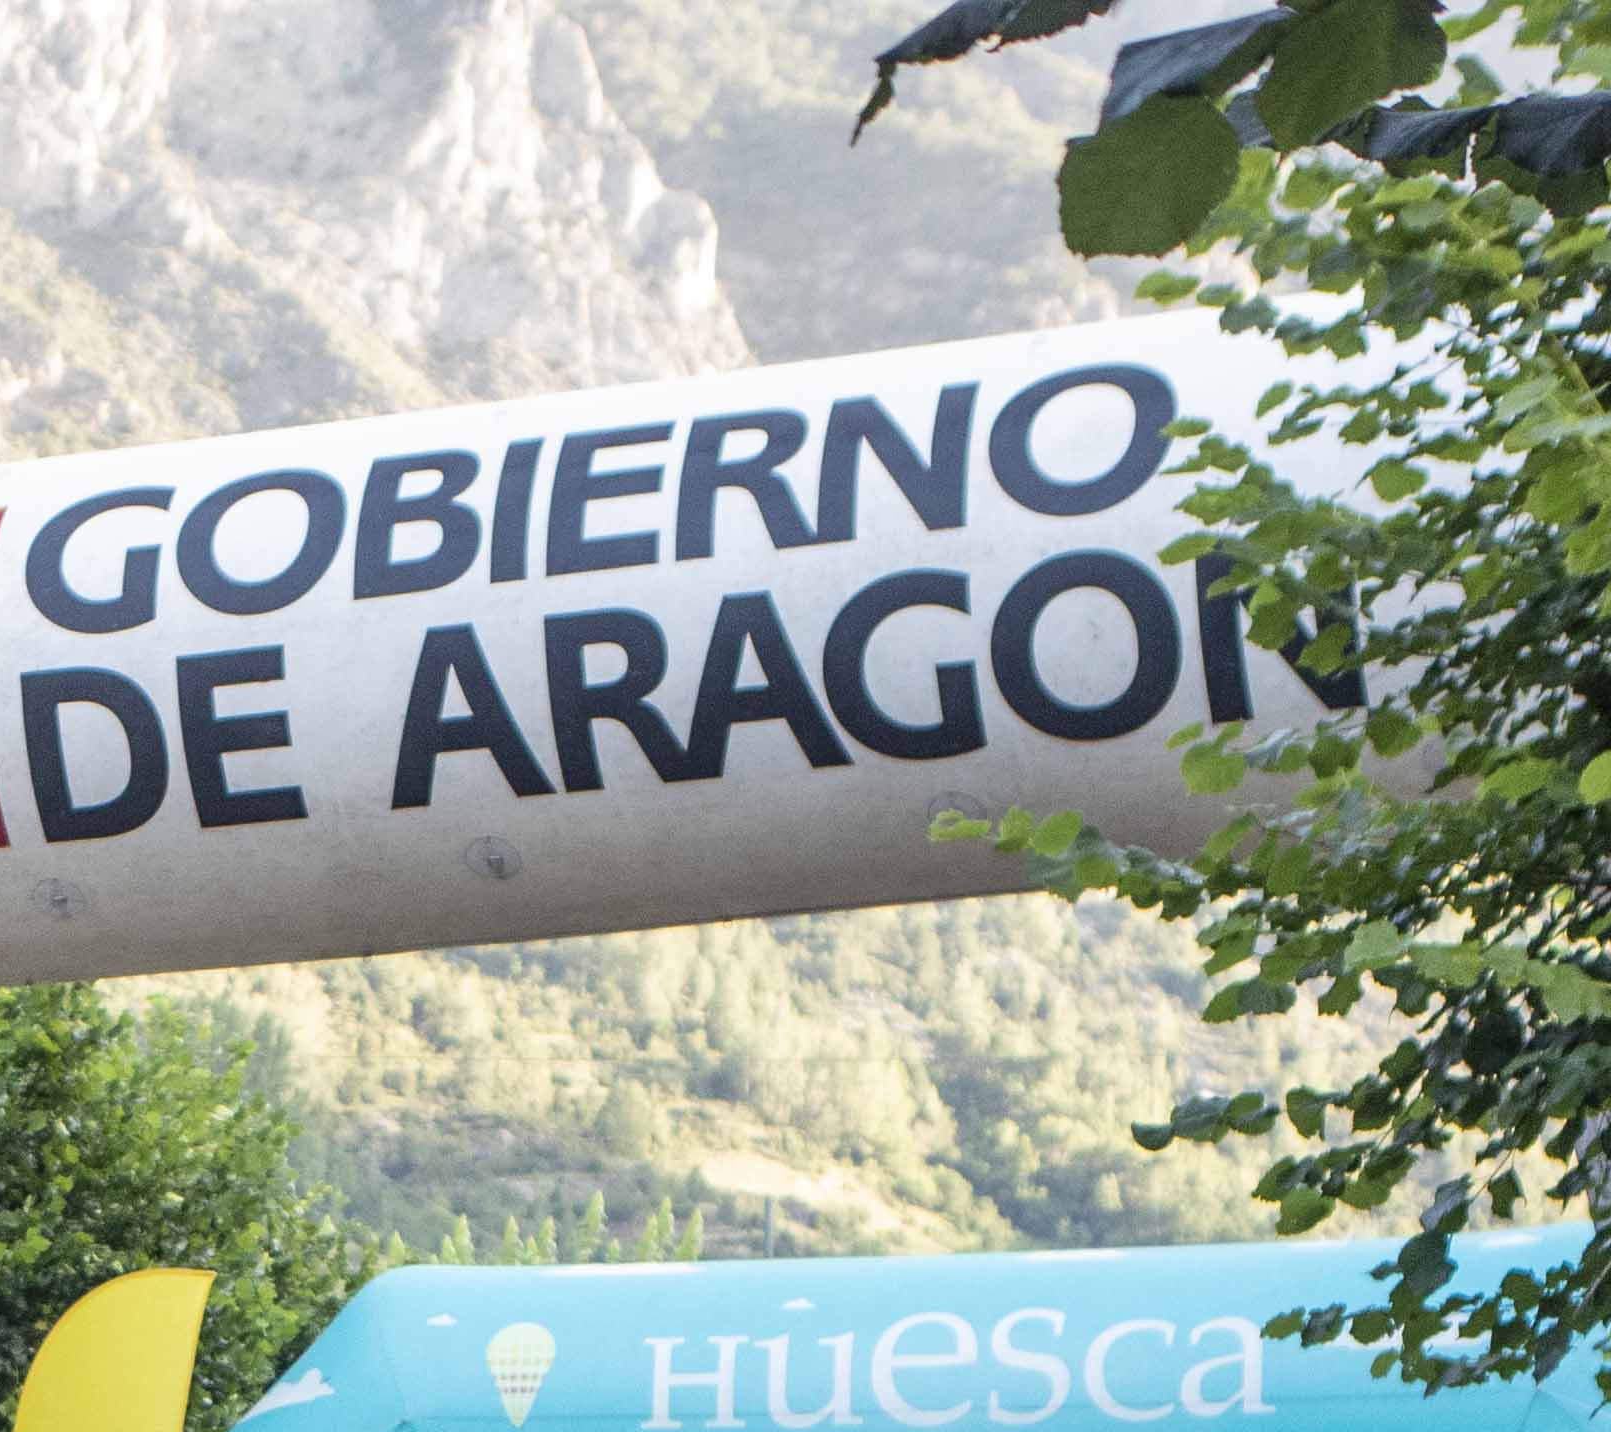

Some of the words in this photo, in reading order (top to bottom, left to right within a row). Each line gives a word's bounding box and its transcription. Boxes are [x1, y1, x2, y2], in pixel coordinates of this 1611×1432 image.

[26, 362, 1179, 636] GOBIERNO
[20, 643, 309, 843] DE
[641, 1306, 1277, 1432] Huesca
